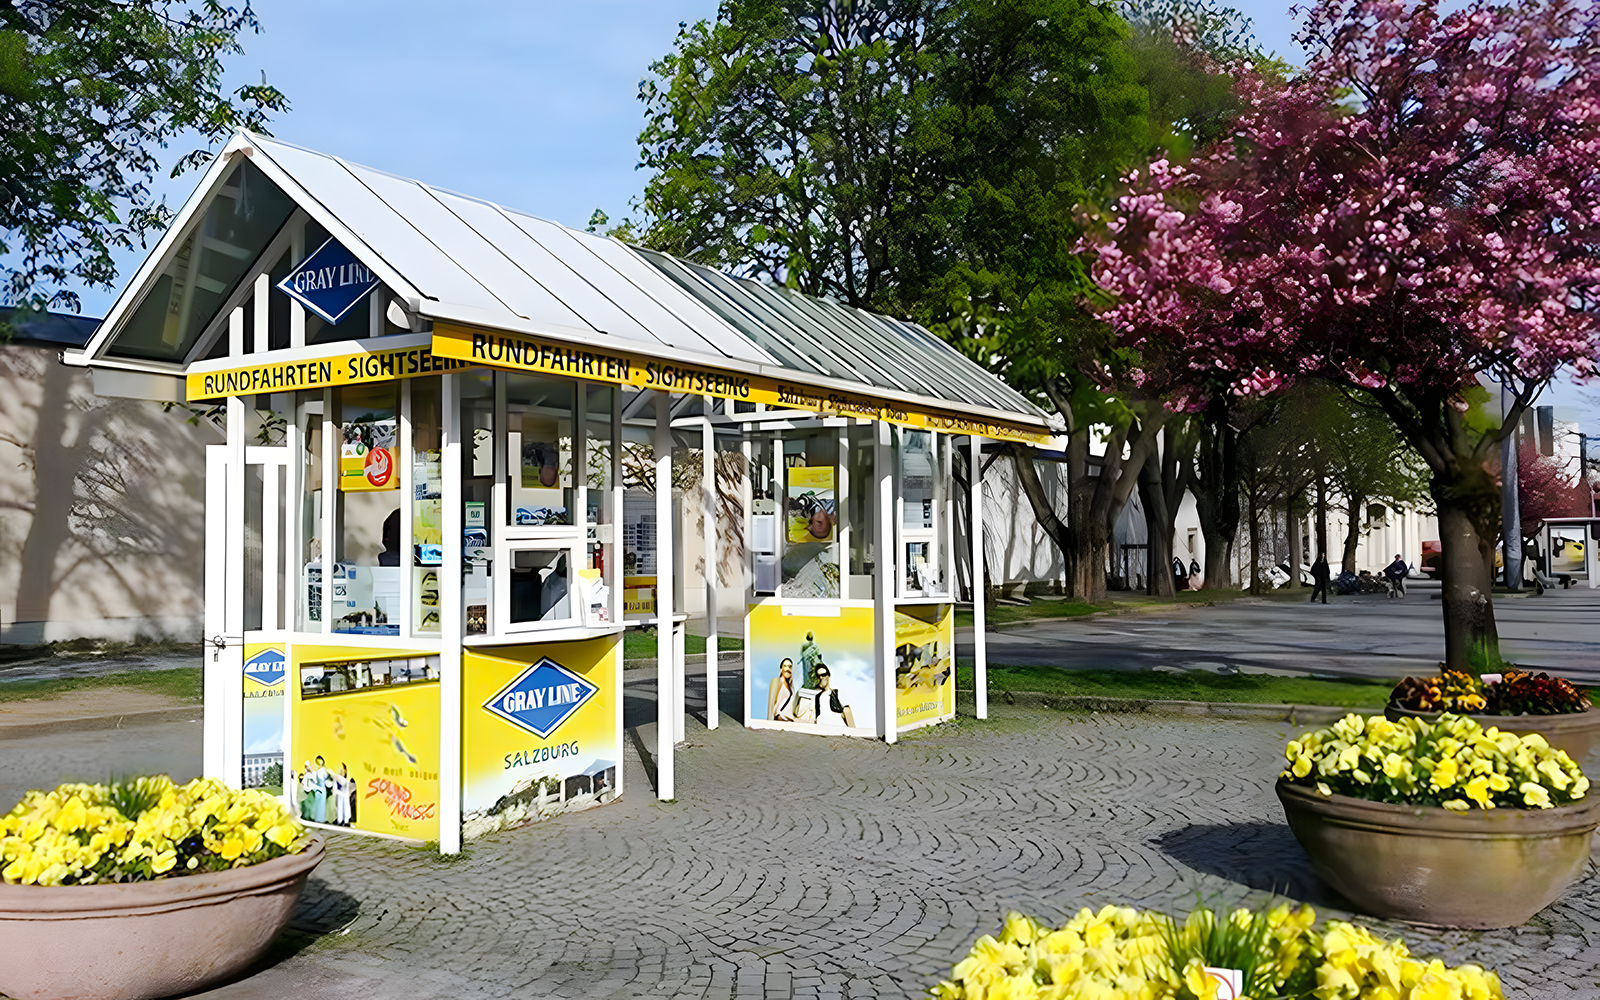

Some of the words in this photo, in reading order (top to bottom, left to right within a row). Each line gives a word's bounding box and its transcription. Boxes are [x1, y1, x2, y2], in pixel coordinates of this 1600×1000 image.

[293, 266, 337, 294] GRAY
[204, 361, 332, 395] RUNDFAHRTEN
[474, 333, 630, 380] RUNDFAHRTEN
[645, 361, 750, 398] SIGHTSEEING
[502, 687, 546, 714] GRAY
[547, 682, 585, 707] LINE
[504, 740, 579, 770] SALZBURG
